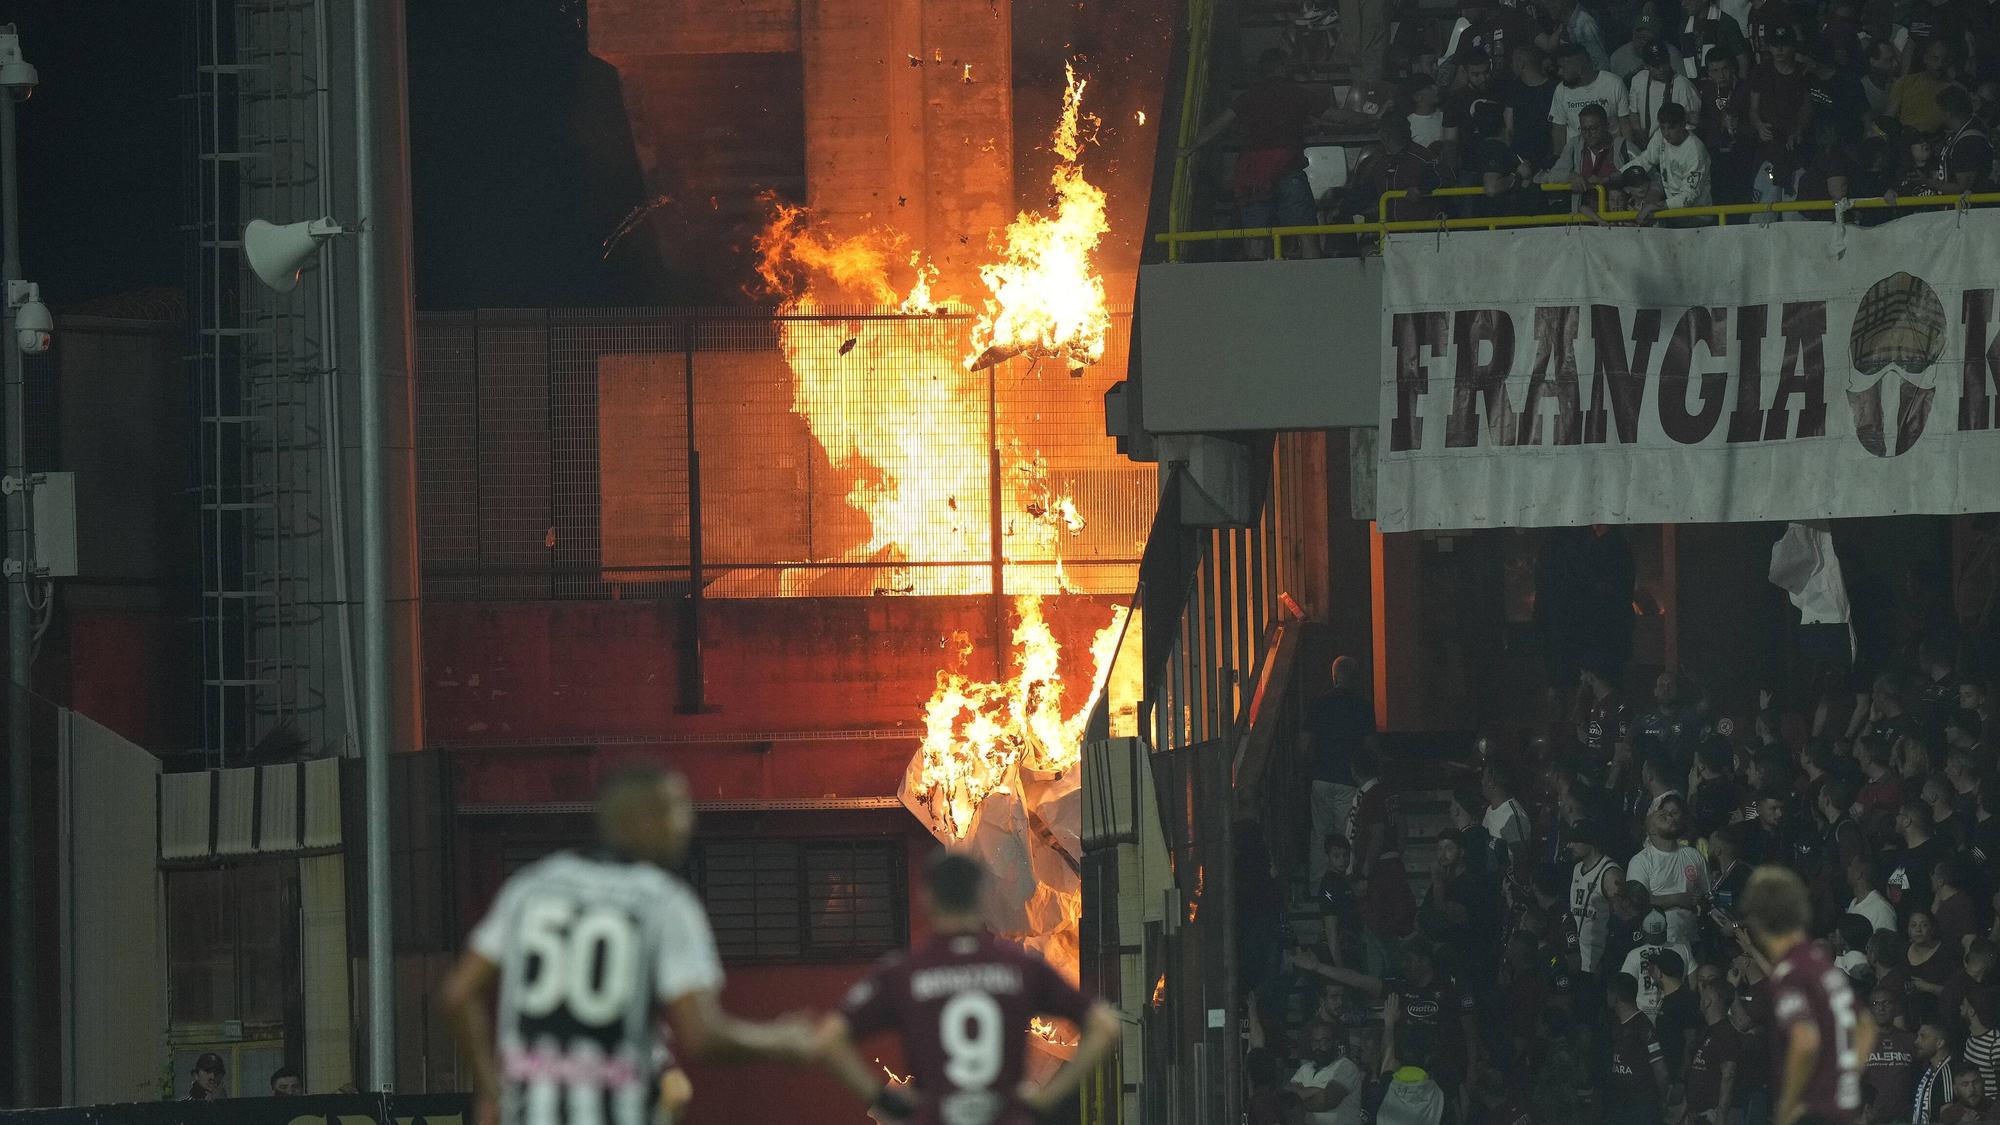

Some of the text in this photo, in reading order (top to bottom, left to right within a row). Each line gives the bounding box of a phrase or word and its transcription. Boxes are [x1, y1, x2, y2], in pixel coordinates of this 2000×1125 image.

[1390, 300, 1828, 452] FRANGIA
[514, 896, 638, 1028] 50
[939, 989, 1005, 1090] 9
[1864, 1051, 1912, 1063] ALERNO
